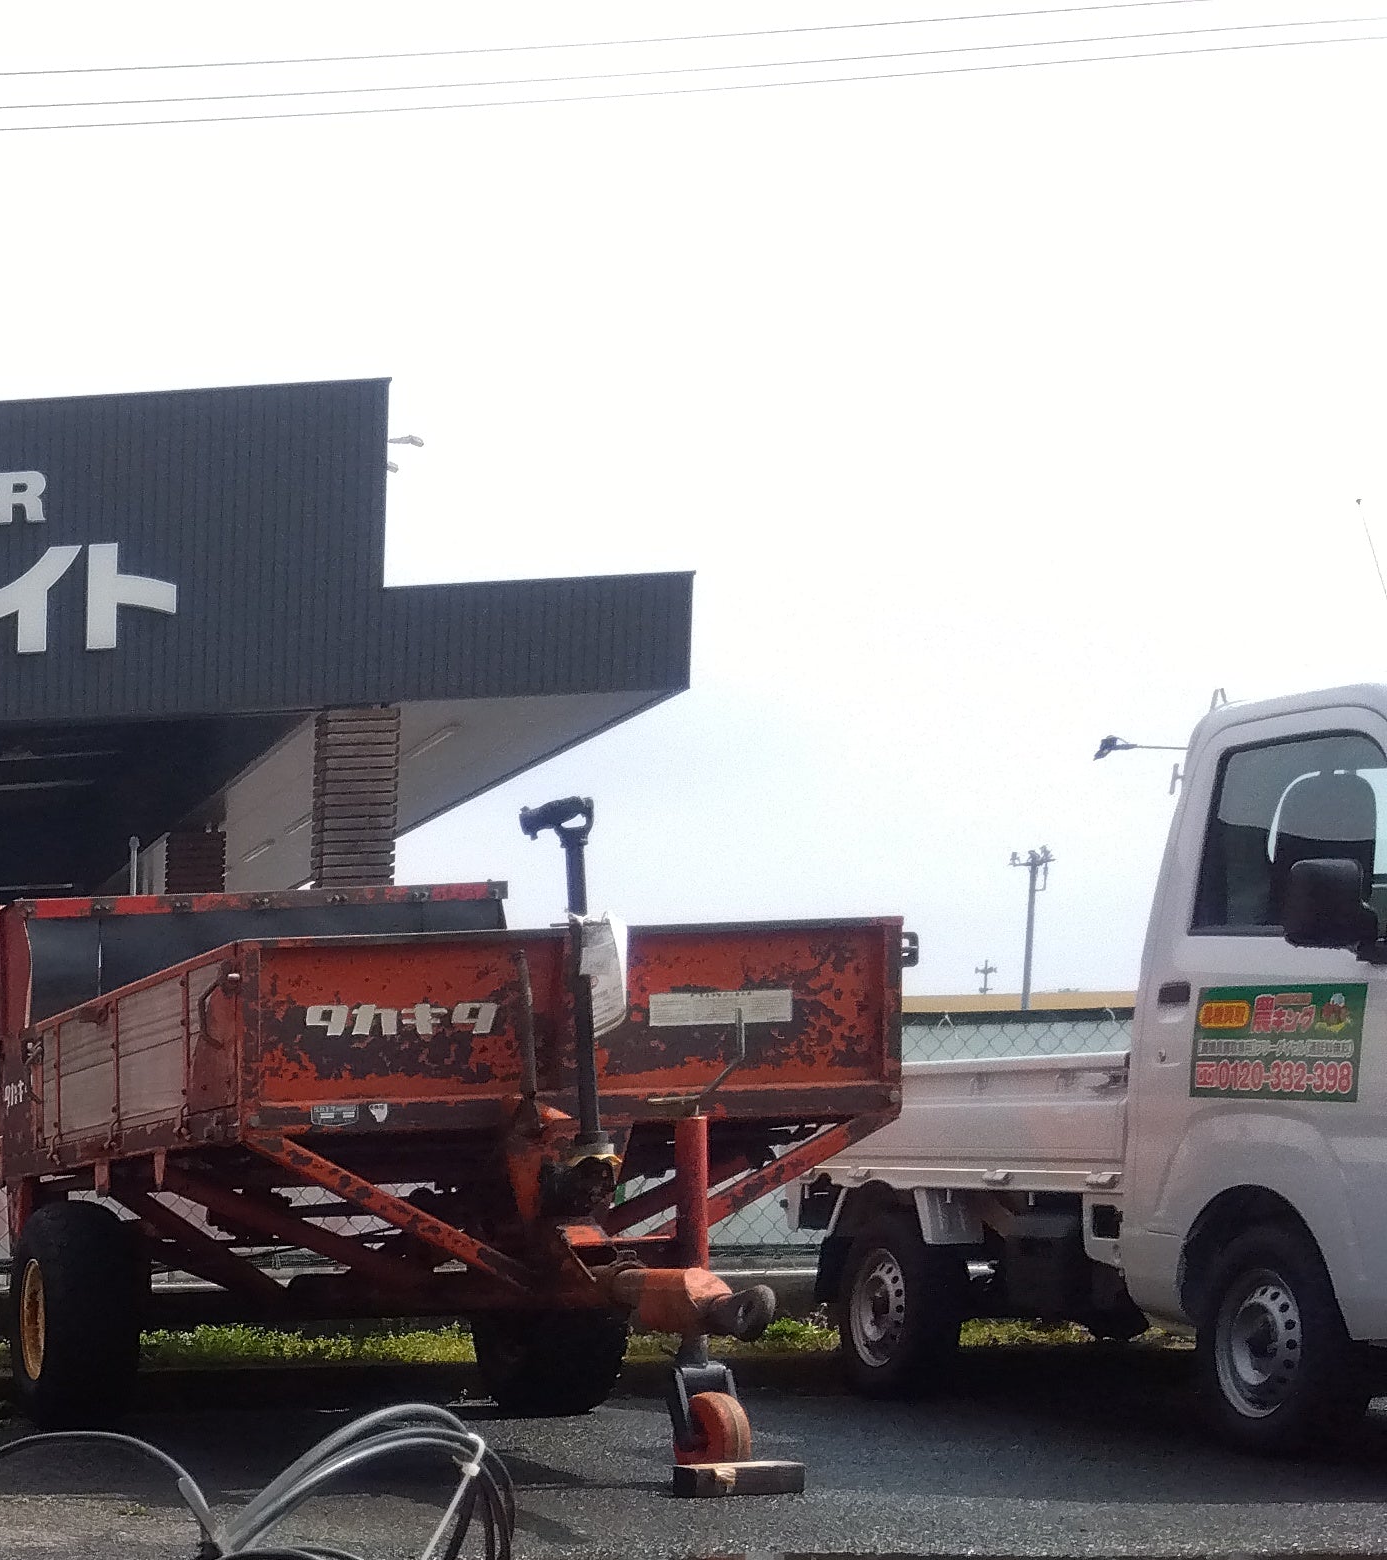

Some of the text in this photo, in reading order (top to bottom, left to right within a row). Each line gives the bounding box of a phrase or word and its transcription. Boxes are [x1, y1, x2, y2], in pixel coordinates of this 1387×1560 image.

[306, 1002, 501, 1036] タカキタ
[1218, 1059, 1354, 1094] 0120-332-398
